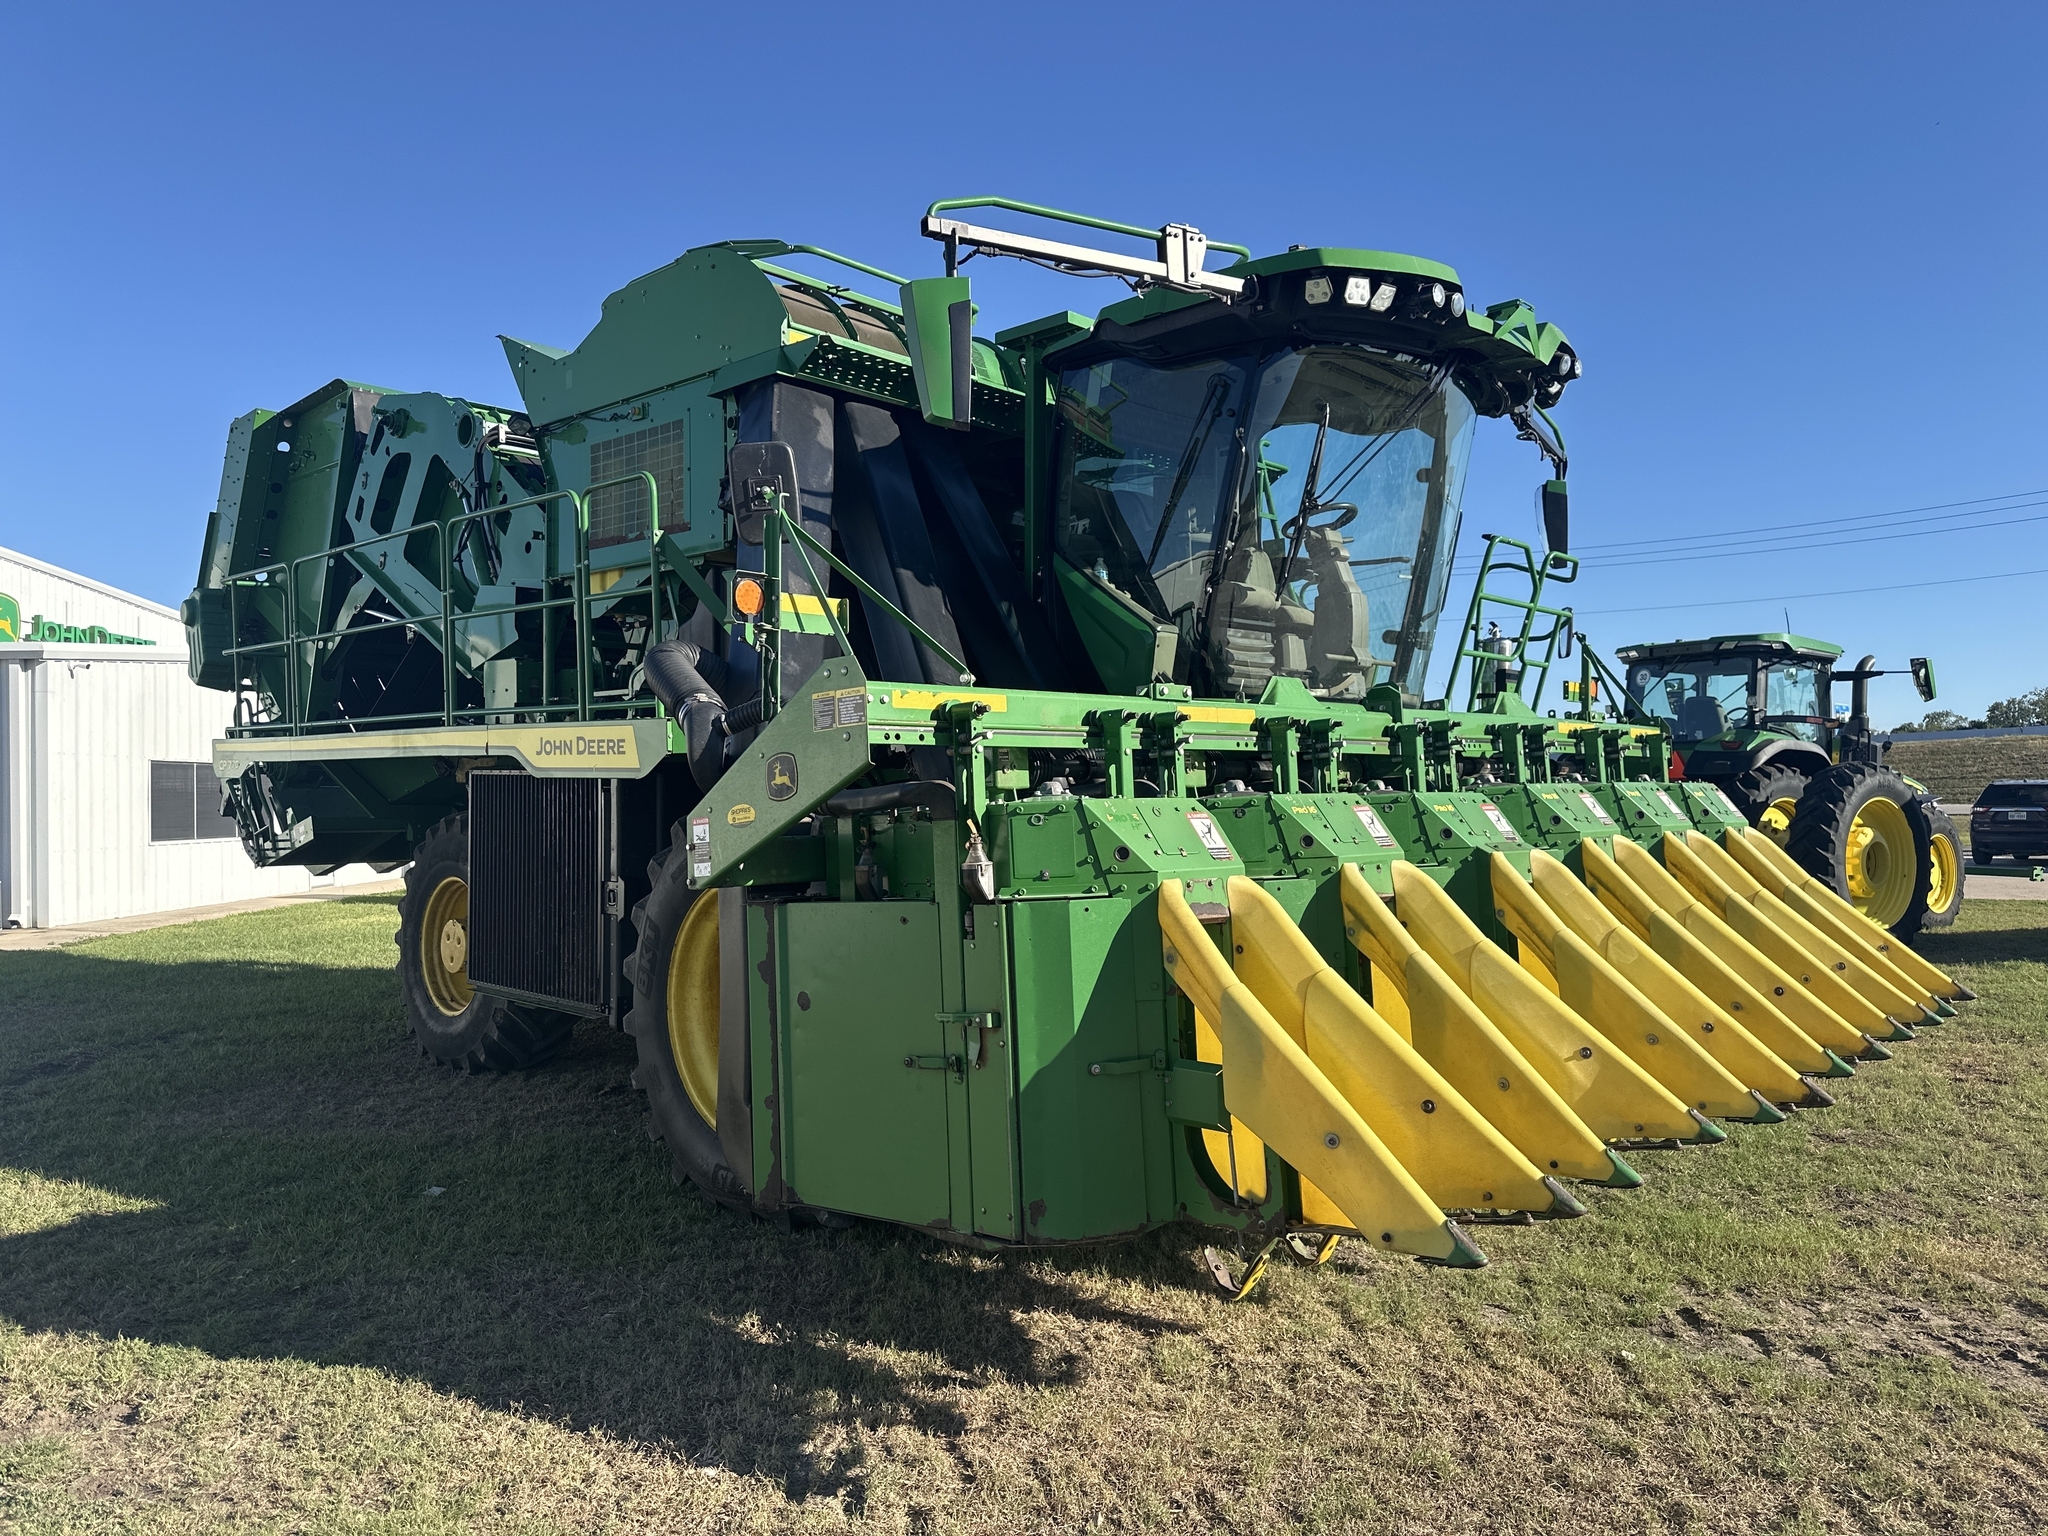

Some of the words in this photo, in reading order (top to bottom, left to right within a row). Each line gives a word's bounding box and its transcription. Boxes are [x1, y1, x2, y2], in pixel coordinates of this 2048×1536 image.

[30, 614, 90, 643] JOHN
[91, 626, 157, 646] DEE
[536, 737, 573, 756] JOHN
[576, 736, 626, 756] DEERE
[637, 918, 656, 996] BKT
